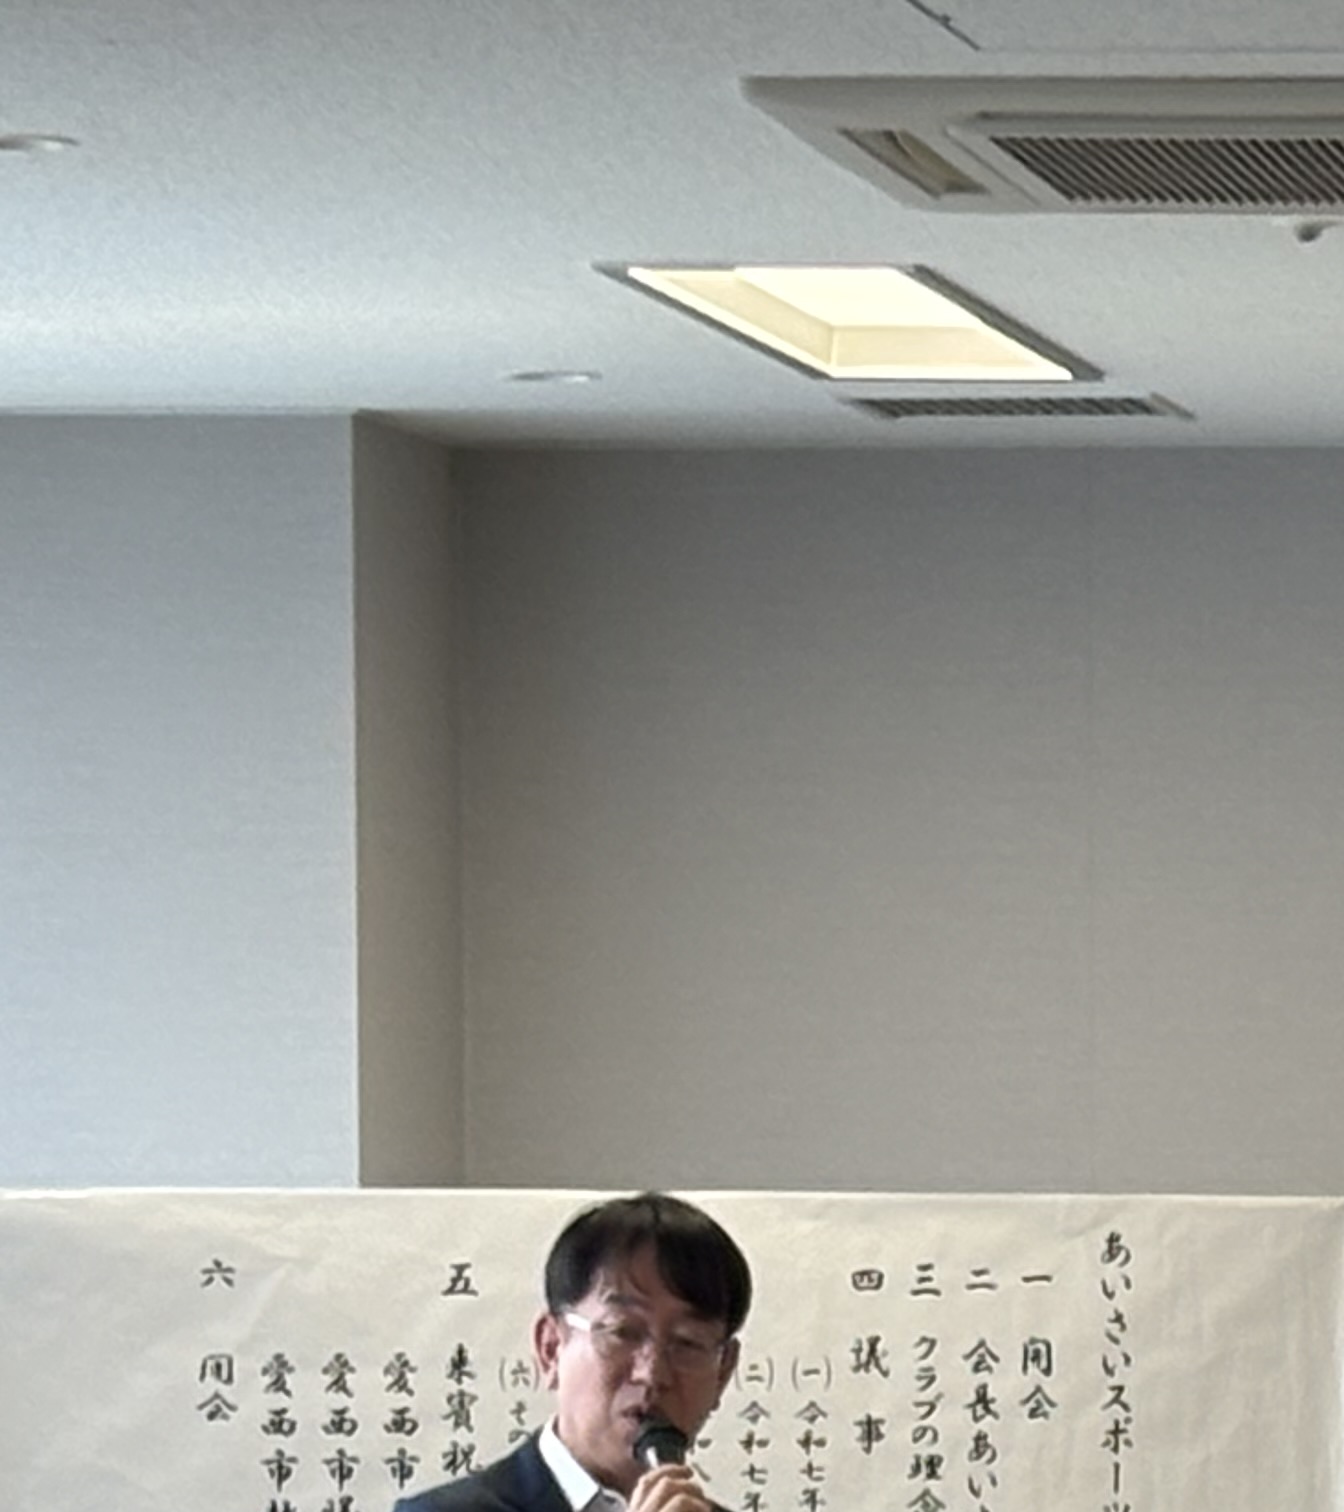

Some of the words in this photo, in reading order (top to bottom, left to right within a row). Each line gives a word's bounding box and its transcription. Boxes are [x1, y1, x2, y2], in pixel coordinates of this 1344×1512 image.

[200, 1258, 236, 1288] 六
[441, 1262, 479, 1297] 五
[851, 1268, 885, 1292] 四
[909, 1262, 942, 1297] 三
[965, 1267, 998, 1291] 二
[1021, 1274, 1054, 1284] 一
[383, 1352, 420, 1490] 愛西市
